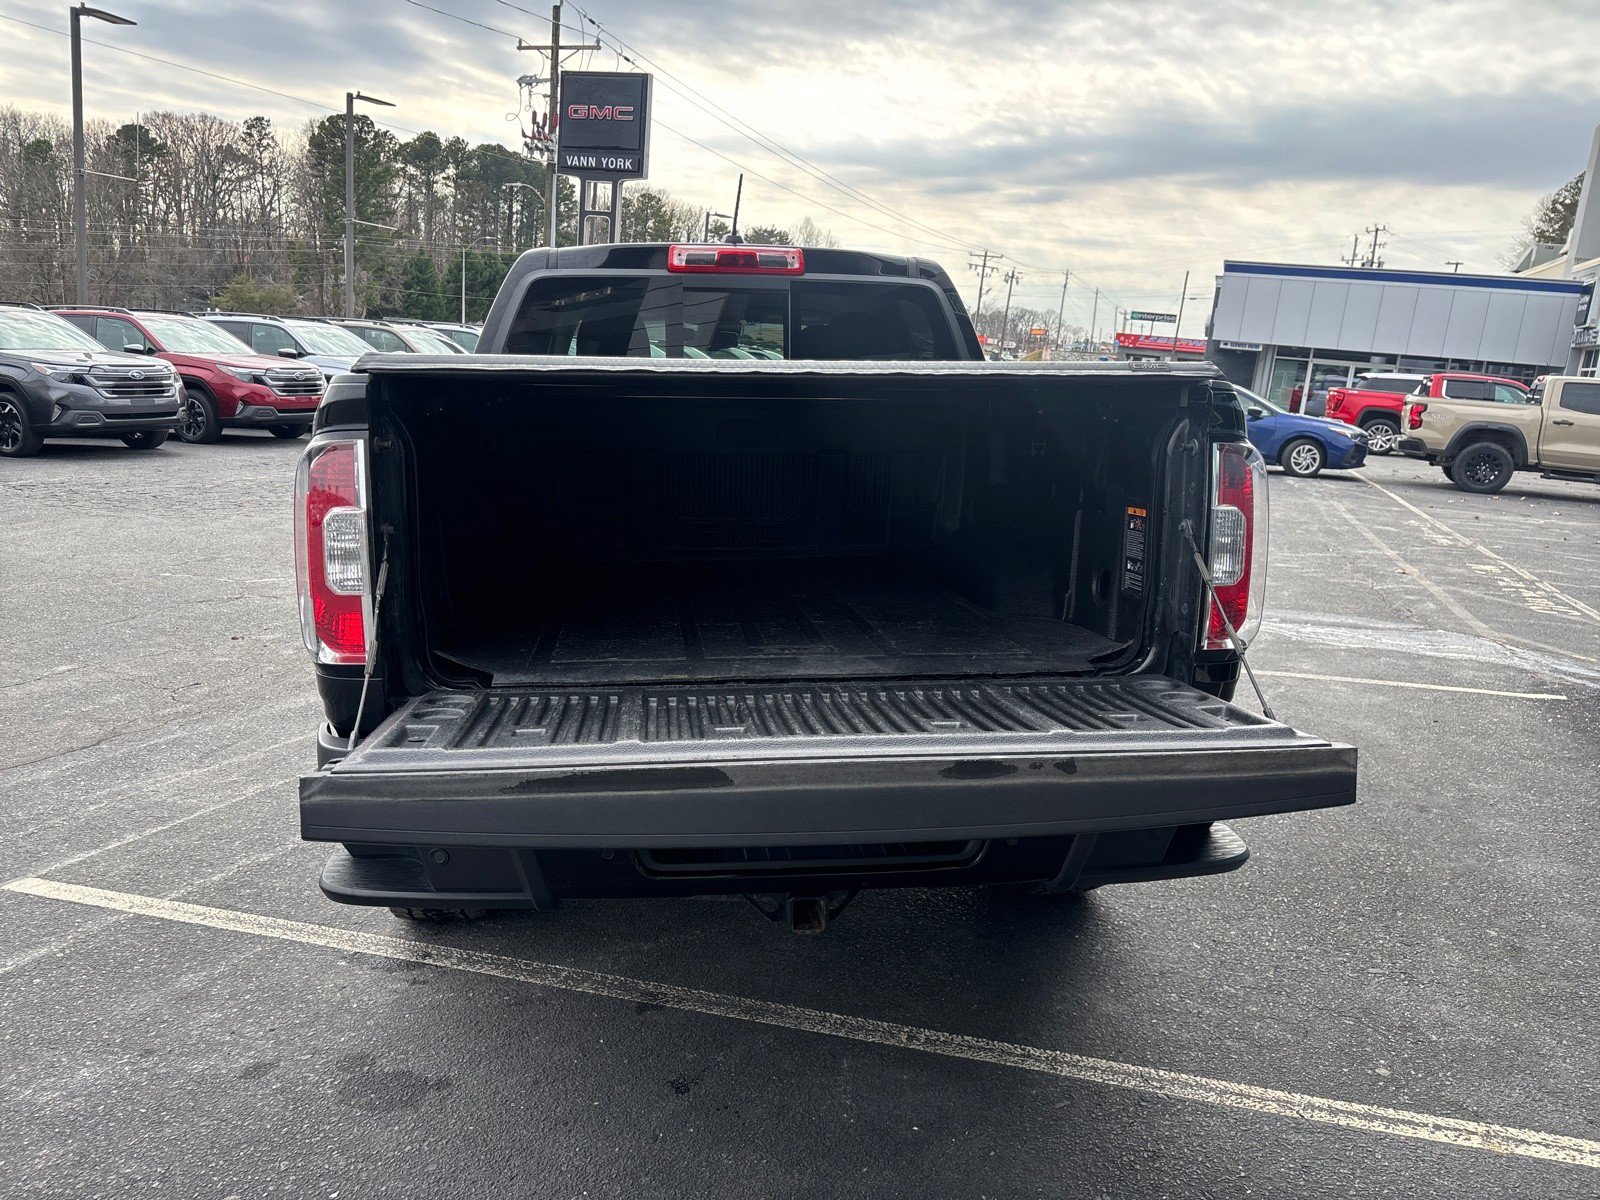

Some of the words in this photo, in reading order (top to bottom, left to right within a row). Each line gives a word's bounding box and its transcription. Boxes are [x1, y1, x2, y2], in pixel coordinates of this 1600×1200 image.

[568, 104, 634, 121] GMC
[566, 155, 596, 168] VANN
[601, 157, 633, 170] YORK
[1132, 312, 1176, 322] enterprise
